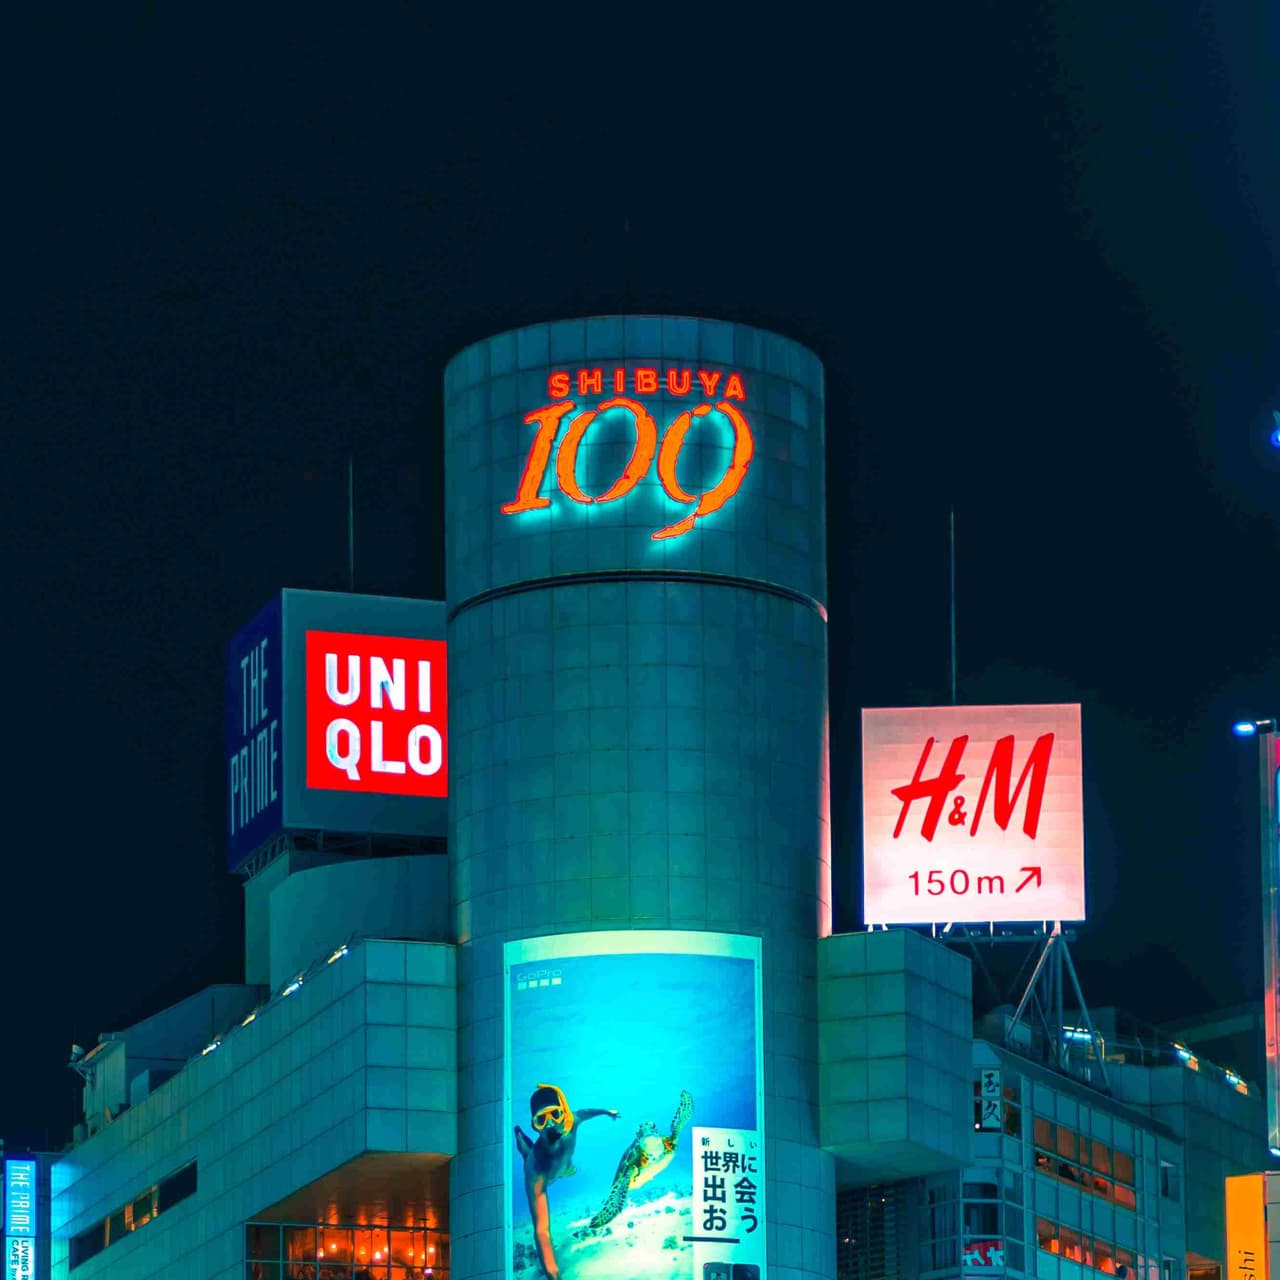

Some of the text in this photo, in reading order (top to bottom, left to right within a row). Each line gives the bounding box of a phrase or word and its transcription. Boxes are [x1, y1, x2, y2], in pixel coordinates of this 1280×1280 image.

[548, 366, 747, 401] SHIBUYA
[499, 396, 755, 541] 109
[240, 636, 269, 737] THE
[325, 652, 432, 713] UNI
[324, 719, 443, 781] QLO
[230, 720, 278, 837] PRIME
[890, 731, 1055, 842] H&M
[699, 1136, 758, 1150] 新しい
[701, 1151, 759, 1175] 世界に
[10, 1164, 30, 1233] THE PRIME
[702, 1176, 758, 1204] 出会
[701, 1205, 758, 1234] おう
[11, 1239, 20, 1266] CAFE
[21, 1239, 30, 1272] LIVING
